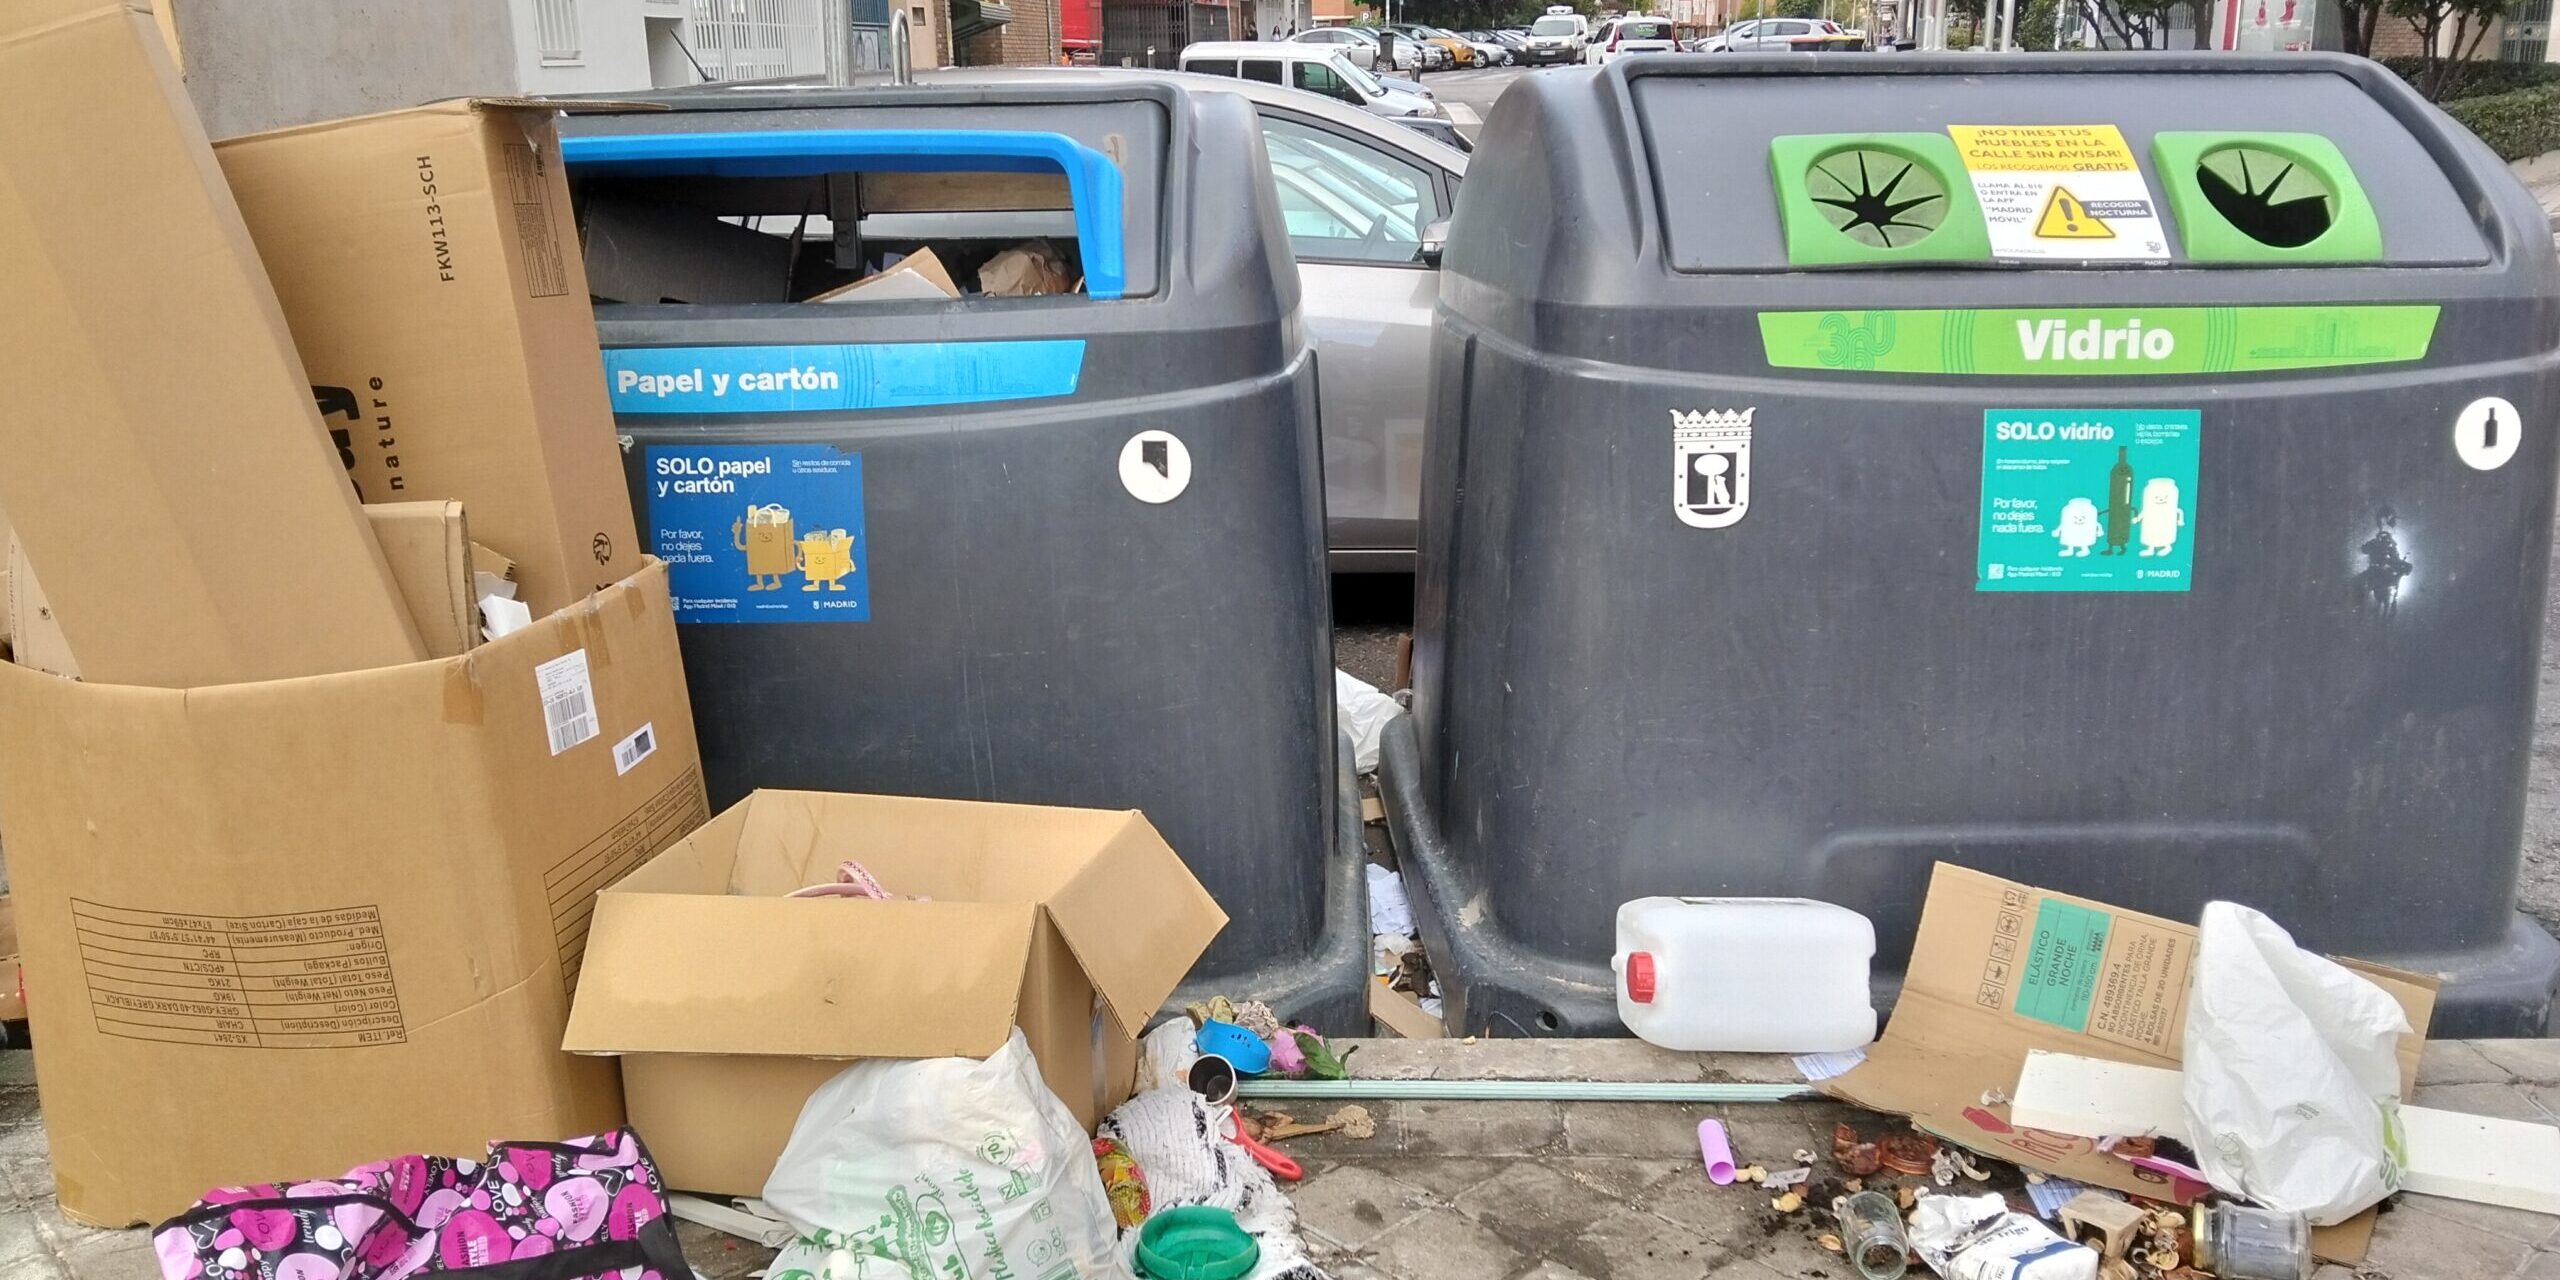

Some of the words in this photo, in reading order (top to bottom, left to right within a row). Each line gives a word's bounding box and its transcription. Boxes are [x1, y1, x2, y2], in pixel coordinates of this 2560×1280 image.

[1969, 150, 2024, 158] CALLE
[2059, 150, 2122, 158] AVISAR!
[2073, 163, 2129, 171] GRATIS
[418, 155, 455, 283] FKW113-SCH
[2018, 319, 2175, 361] Vidrio
[618, 370, 702, 397] Papel
[714, 373, 730, 396] y
[739, 366, 838, 391] cartón
[369, 375, 406, 491] nature
[1996, 422, 2054, 441] SOLO
[2059, 422, 2114, 441] vidrio
[656, 458, 714, 474] SOLO
[719, 457, 770, 478] papel
[658, 480, 667, 497] y
[674, 476, 734, 493] cartón
[1993, 498, 2012, 509] Por
[2012, 498, 2038, 510] favor,
[1993, 512, 2006, 521] no
[2008, 510, 2035, 523] dejes
[661, 529, 676, 539] Por
[678, 528, 704, 540] favor,
[1993, 522, 2017, 533] nada
[2018, 522, 2045, 534] fuera.
[662, 542, 673, 552] no
[676, 540, 702, 554] dejes
[662, 554, 686, 563] nada
[688, 553, 714, 563] fuera.
[2147, 570, 2180, 578] MADRID
[287, 914, 308, 928] caja
[310, 917, 318, 927] la
[321, 915, 332, 925] de
[335, 910, 376, 923] Medidas
[225, 921, 248, 932] Size)
[251, 917, 286, 930] (Carton
[308, 930, 355, 941] Producto
[358, 925, 379, 936] Med.
[232, 932, 307, 946] (Measurements)
[346, 940, 382, 952] Origen:
[202, 949, 221, 959] RPC
[2027, 929, 2052, 986] ELÁSTICO
[2142, 937, 2158, 972] GRANDE
[2160, 937, 2177, 978] UNIDADES
[182, 962, 225, 973] 4PCS/CTN
[304, 958, 352, 972] (Package)
[354, 955, 386, 968] Bultos
[2046, 937, 2068, 987] GRANDE
[2059, 944, 2078, 987] NOCHE
[207, 977, 231, 987] 21KG
[272, 976, 312, 989] Weight)
[313, 975, 338, 986] (Total
[340, 974, 363, 985] Total
[366, 971, 389, 982] Peso
[2110, 963, 2132, 1021] ABSORBENTES
[2125, 940, 2137, 962] PARA
[368, 985, 392, 996] Peso
[2103, 962, 2122, 1009] 489369.4
[2136, 973, 2149, 998] TALLA
[2158, 980, 2166, 991] 20
[213, 991, 236, 1002] 19KG
[323, 989, 342, 1001] (Net
[343, 988, 366, 999] Neto
[2117, 973, 2139, 1035] INCONTINENCIA
[2133, 960, 2141, 972] DE
[2155, 992, 2163, 1004] DE
[155, 1001, 178, 1012] DARK
[334, 1002, 367, 1015] (Color)
[369, 1000, 396, 1011] Color
[216, 1020, 244, 1030] CHAIR
[280, 1018, 340, 1031] (Description)
[341, 1015, 399, 1029] Descripción
[2097, 1009, 2110, 1030] C.N.
[2124, 999, 2142, 1038] ELÁSTICO
[2146, 1004, 2160, 1036] BOLSAS
[358, 1032, 381, 1043] ITEM
[383, 1029, 403, 1041] Ref.
[2144, 1036, 2151, 1044] 4
[640, 1157, 661, 1193] LOVE
[487, 1179, 507, 1222] LOVE
[561, 1189, 579, 1225] FASHION
[292, 1208, 318, 1244] trendy
